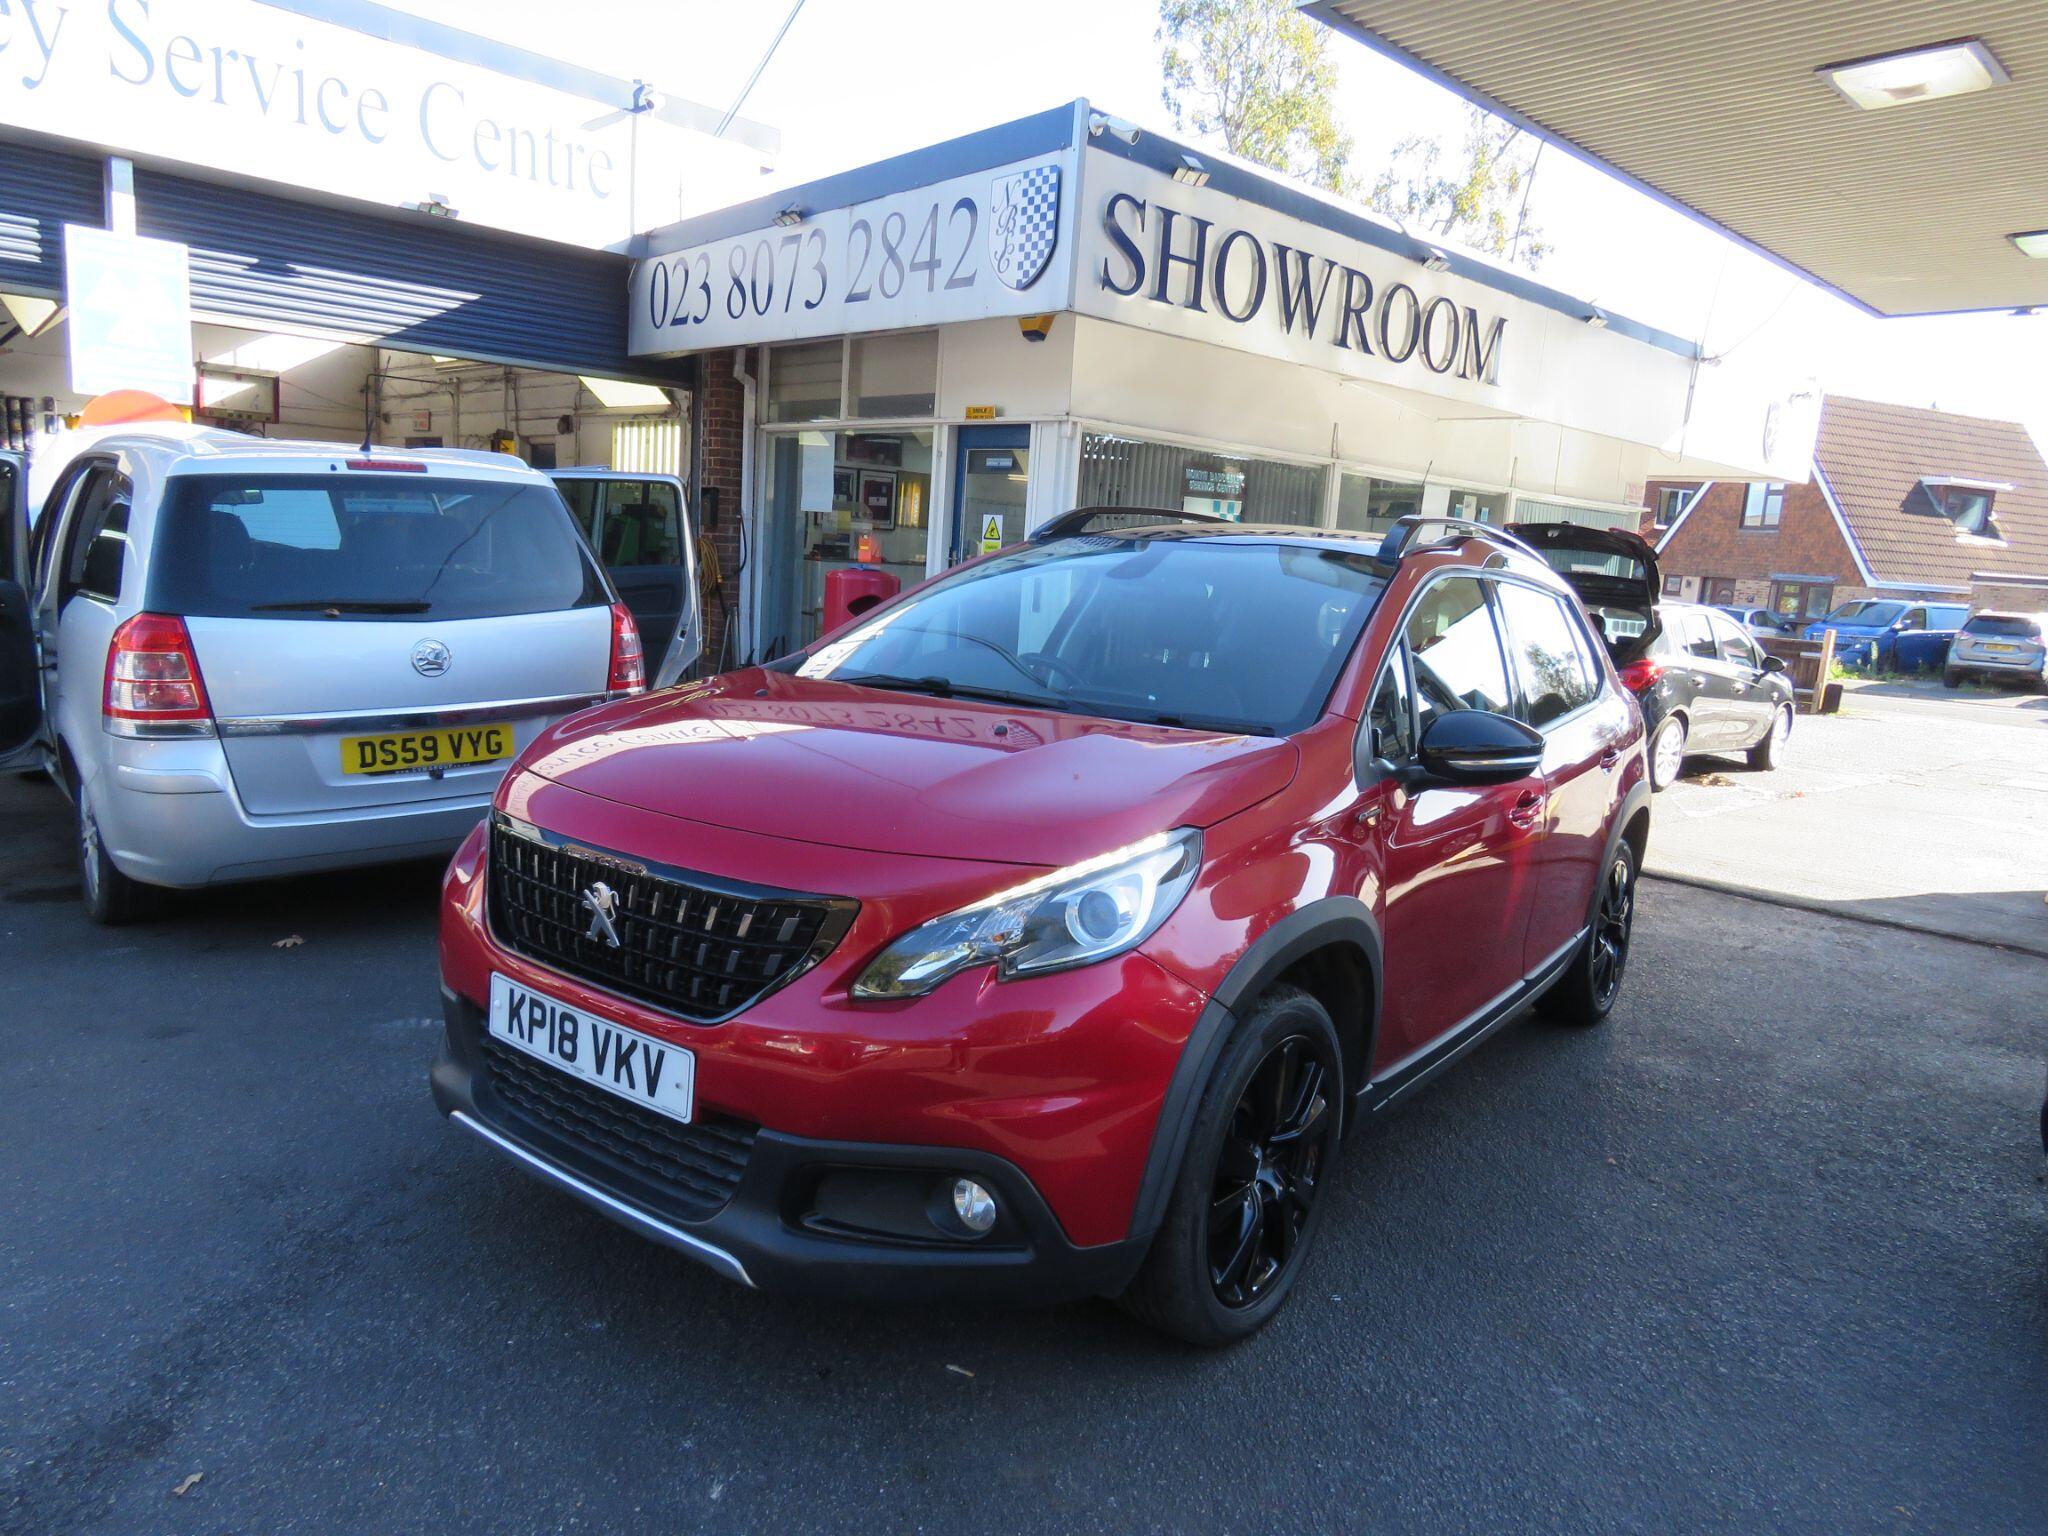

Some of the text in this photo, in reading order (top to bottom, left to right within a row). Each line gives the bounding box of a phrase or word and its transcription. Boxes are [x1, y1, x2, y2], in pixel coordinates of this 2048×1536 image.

[107, 0, 389, 145] Service
[418, 81, 613, 199] Centre
[650, 197, 978, 329] 023 8073 2842
[1101, 193, 1508, 386] SHOWROOM
[358, 729, 503, 769] DS59 VYG
[508, 987, 666, 1098] KP18 VKV
